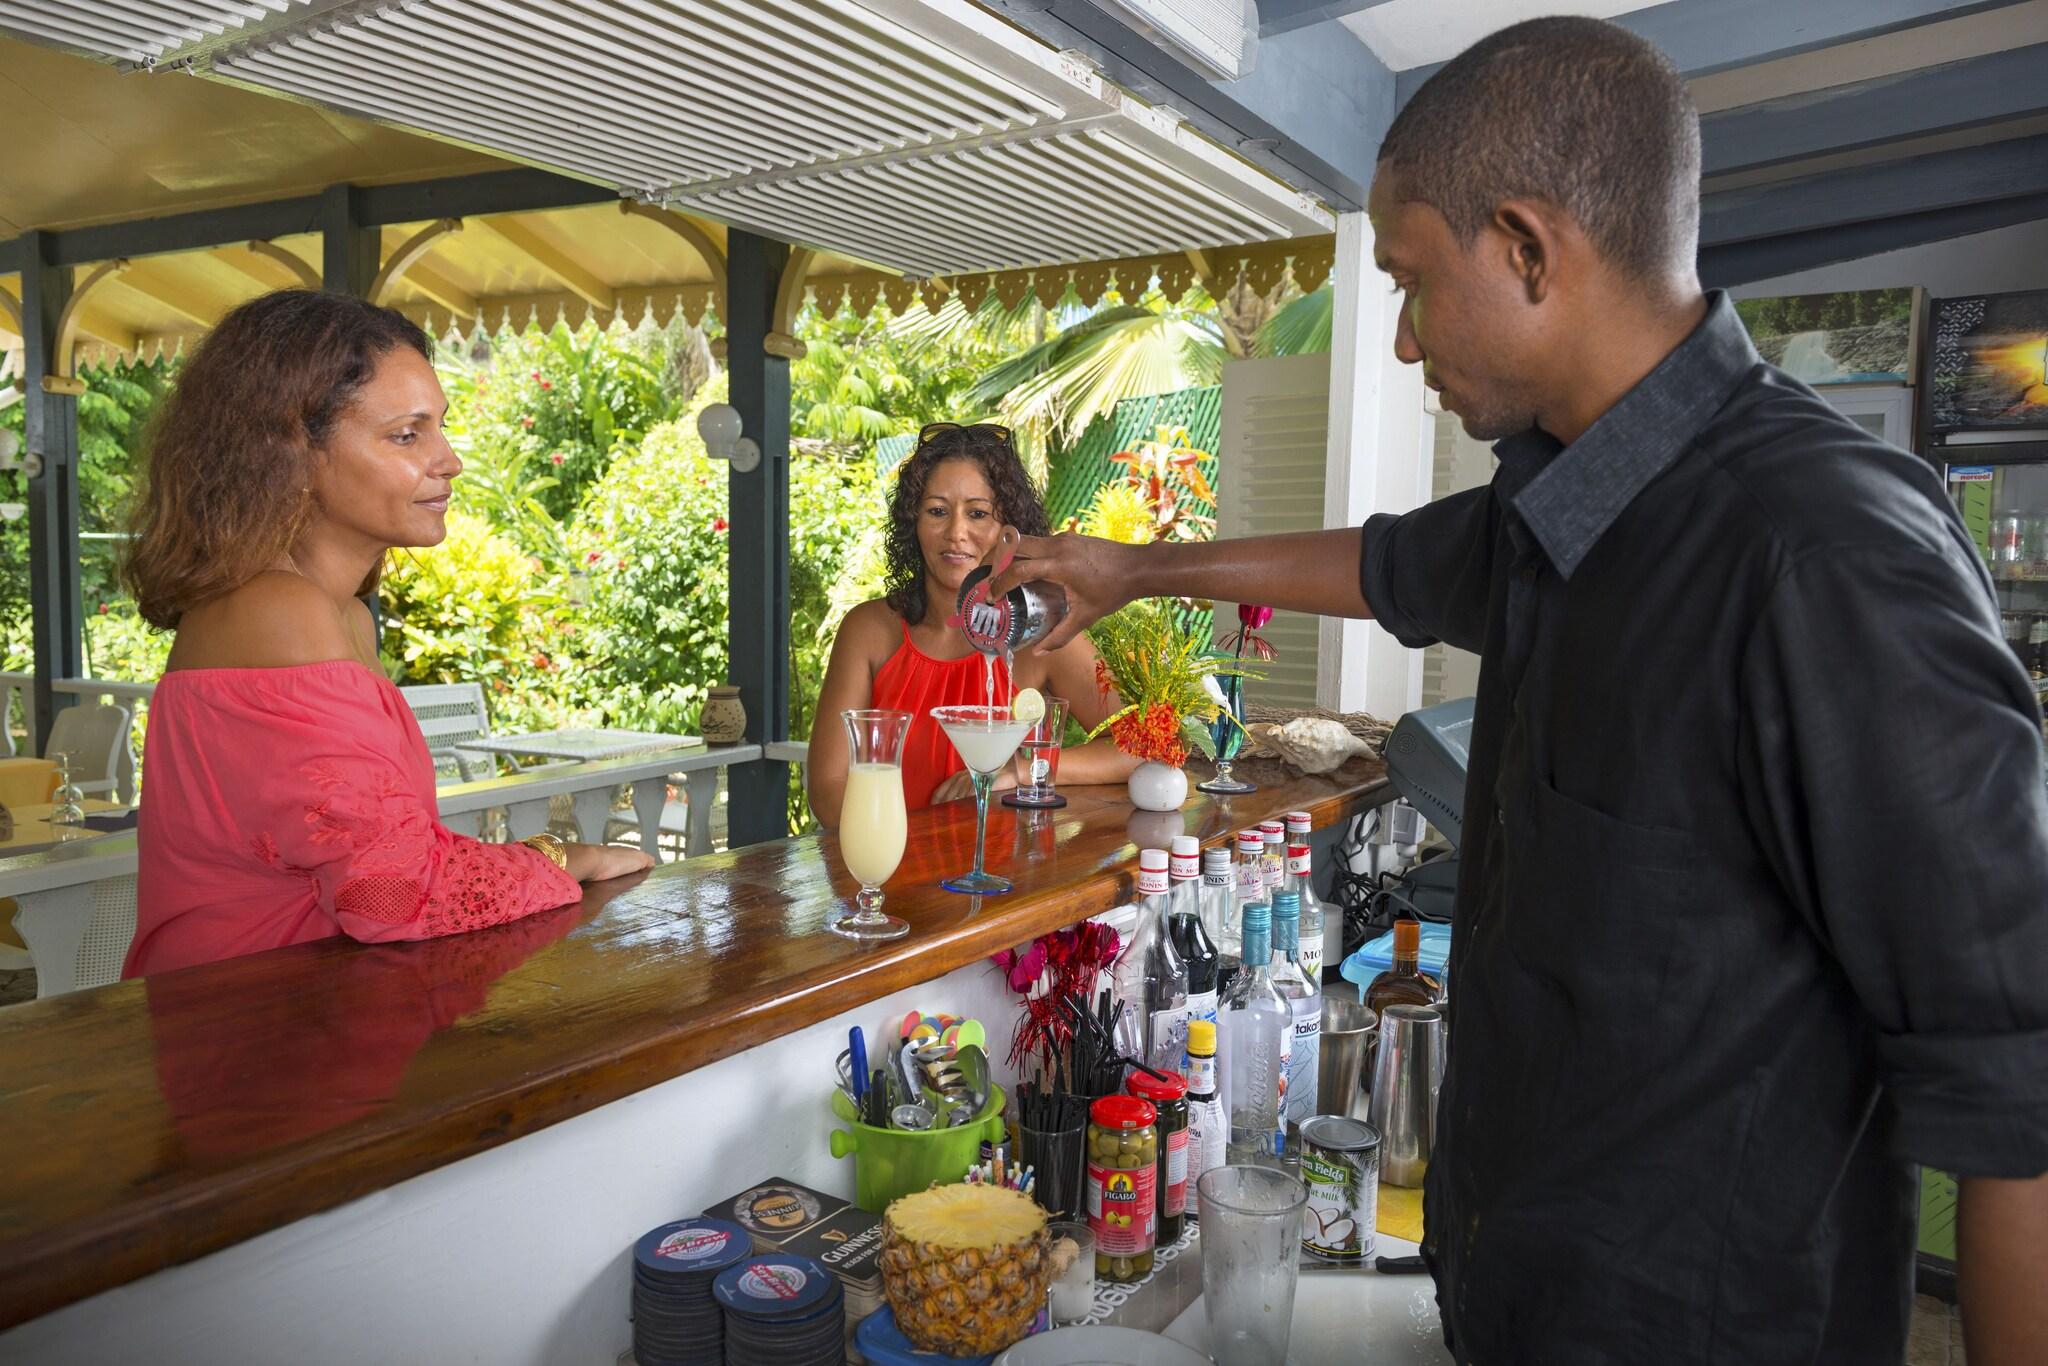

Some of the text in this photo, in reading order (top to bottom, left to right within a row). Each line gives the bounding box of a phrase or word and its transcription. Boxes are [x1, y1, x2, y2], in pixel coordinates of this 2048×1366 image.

[1314, 1163, 1344, 1181] Fields
[1104, 1191, 1137, 1201] FIGARO
[1320, 1191, 1340, 1202] Milk
[656, 1232, 727, 1256] SeyBrew
[821, 1224, 884, 1263] GUINNESS
[752, 1264, 797, 1299] SeyBrew
